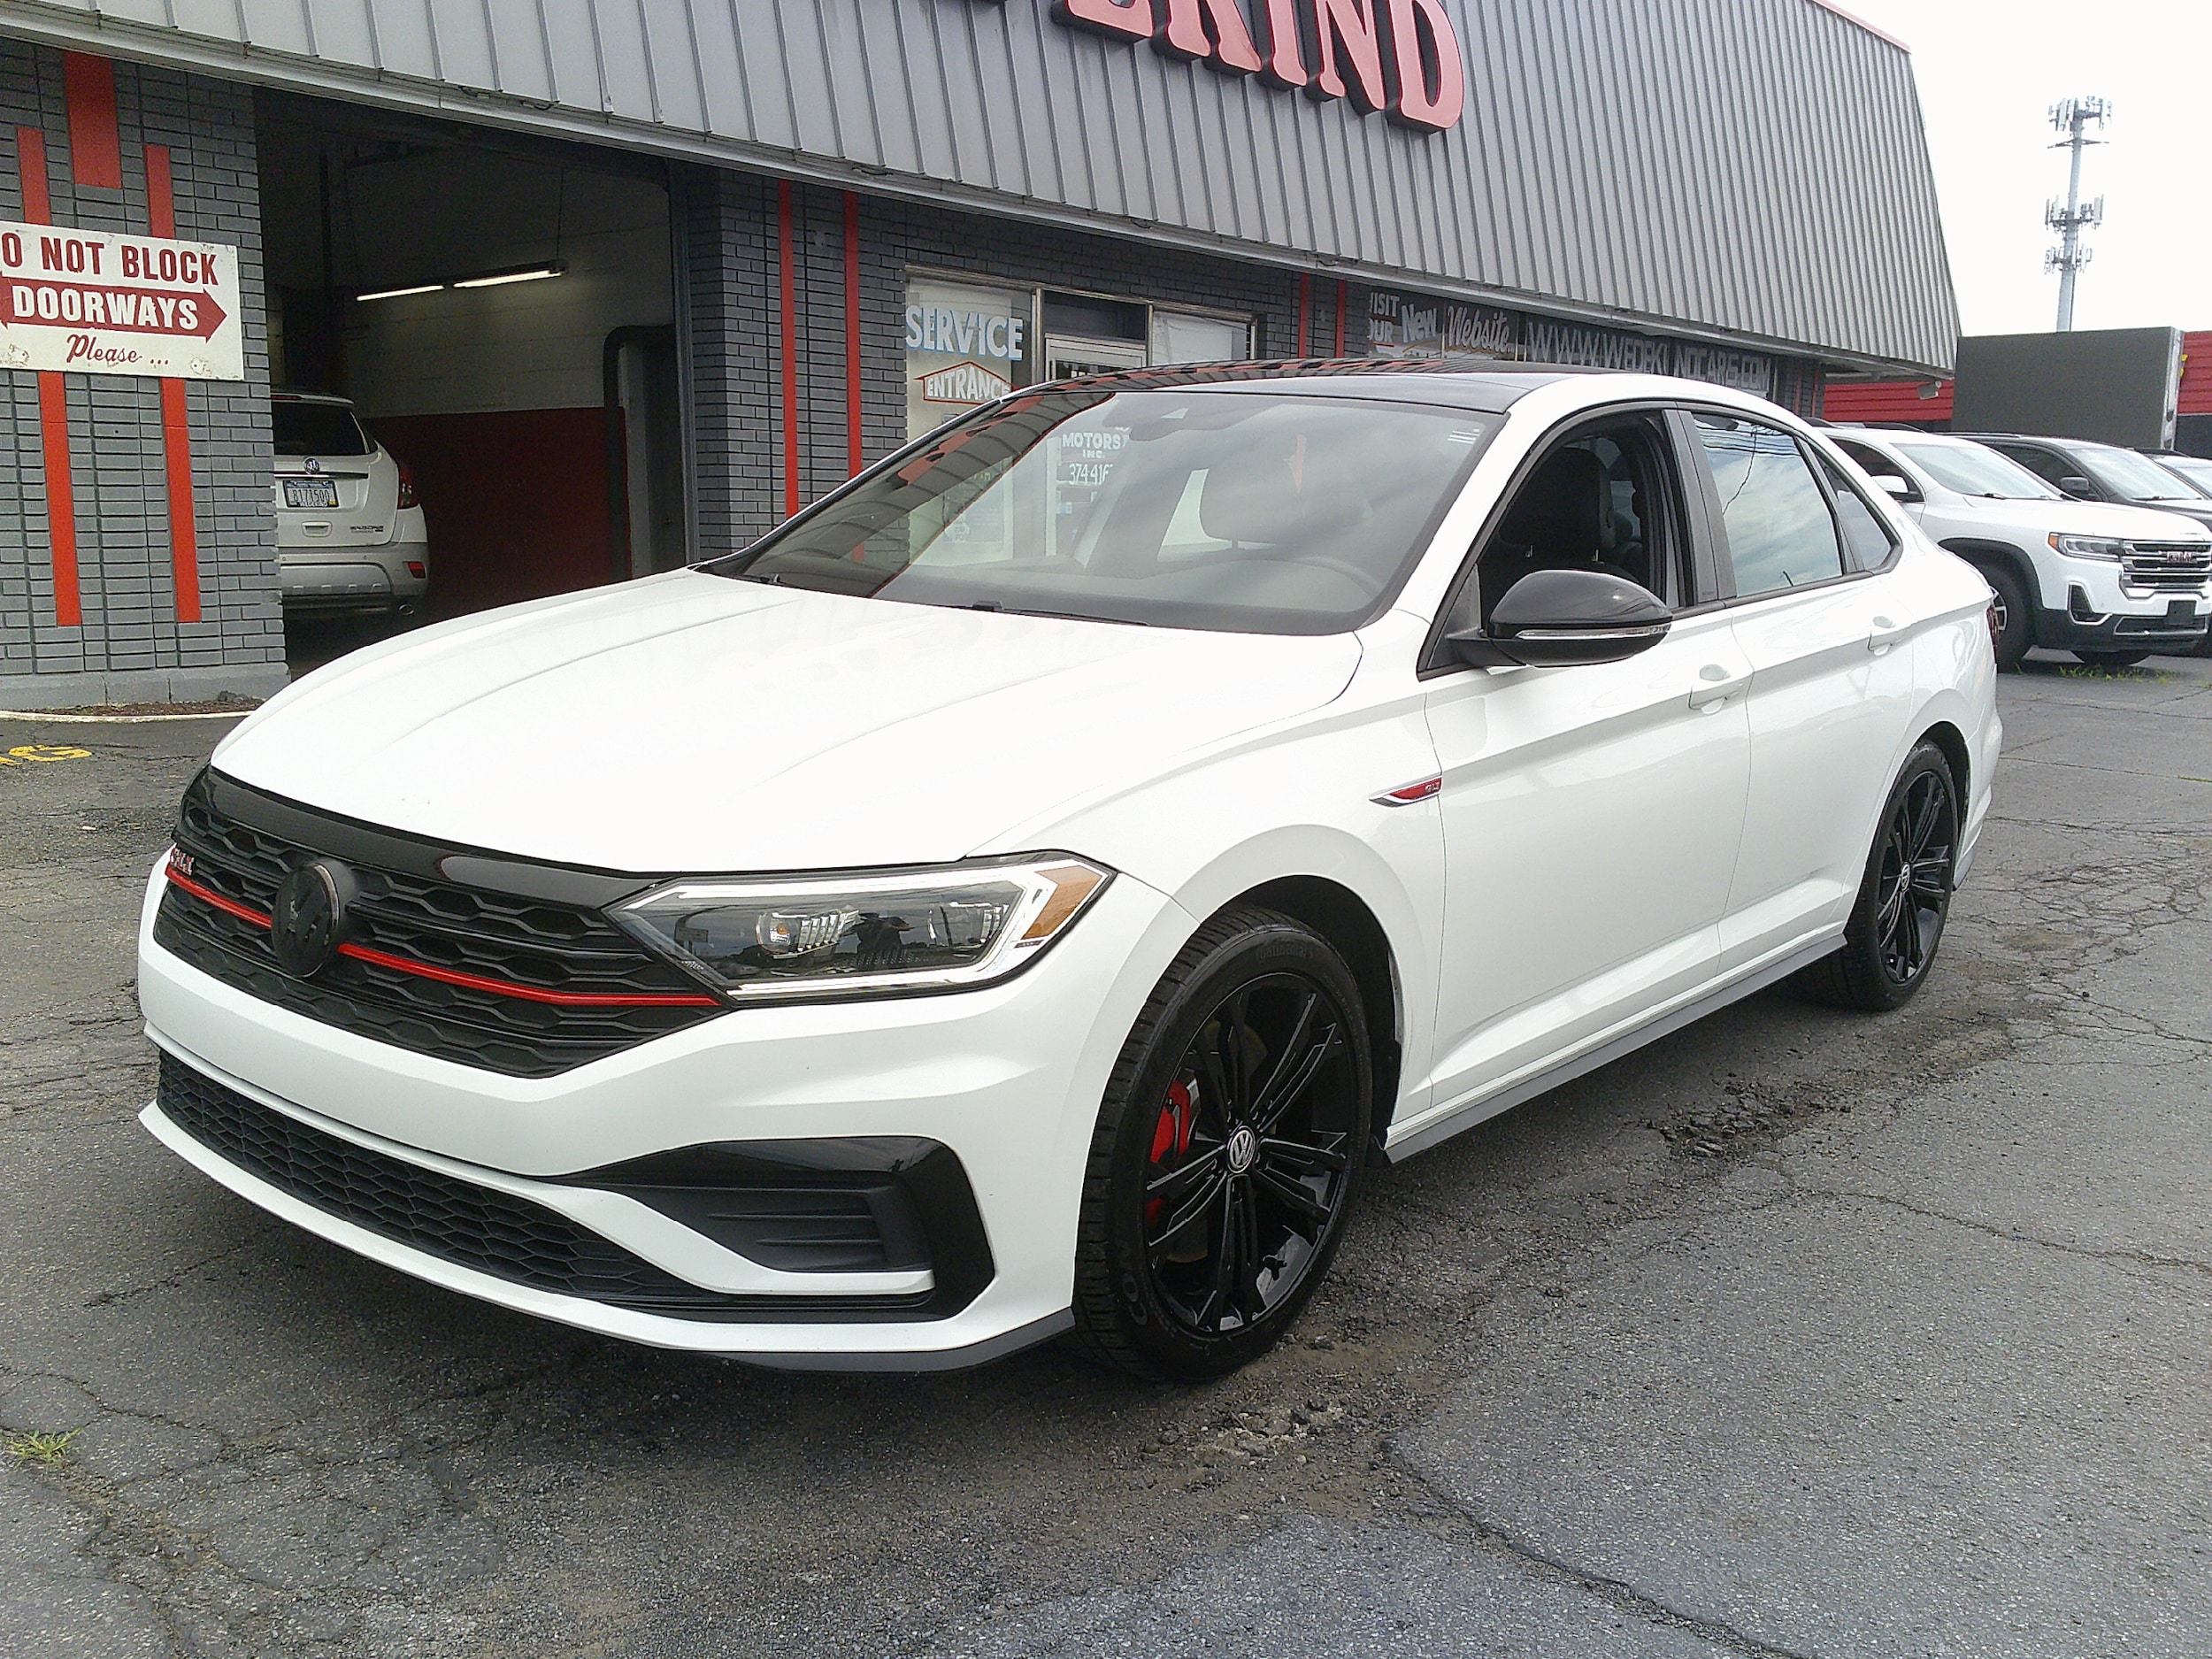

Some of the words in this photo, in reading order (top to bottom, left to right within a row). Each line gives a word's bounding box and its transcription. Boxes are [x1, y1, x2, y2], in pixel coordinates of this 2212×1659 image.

[40, 236, 105, 275] NOT
[121, 244, 219, 286] BLOCK
[12, 285, 199, 330] DOORWAYS
[1402, 303, 1437, 343] New
[65, 334, 143, 364] Please
[905, 304, 1024, 362] SERVICE
[1062, 432, 1121, 449] MOTORS
